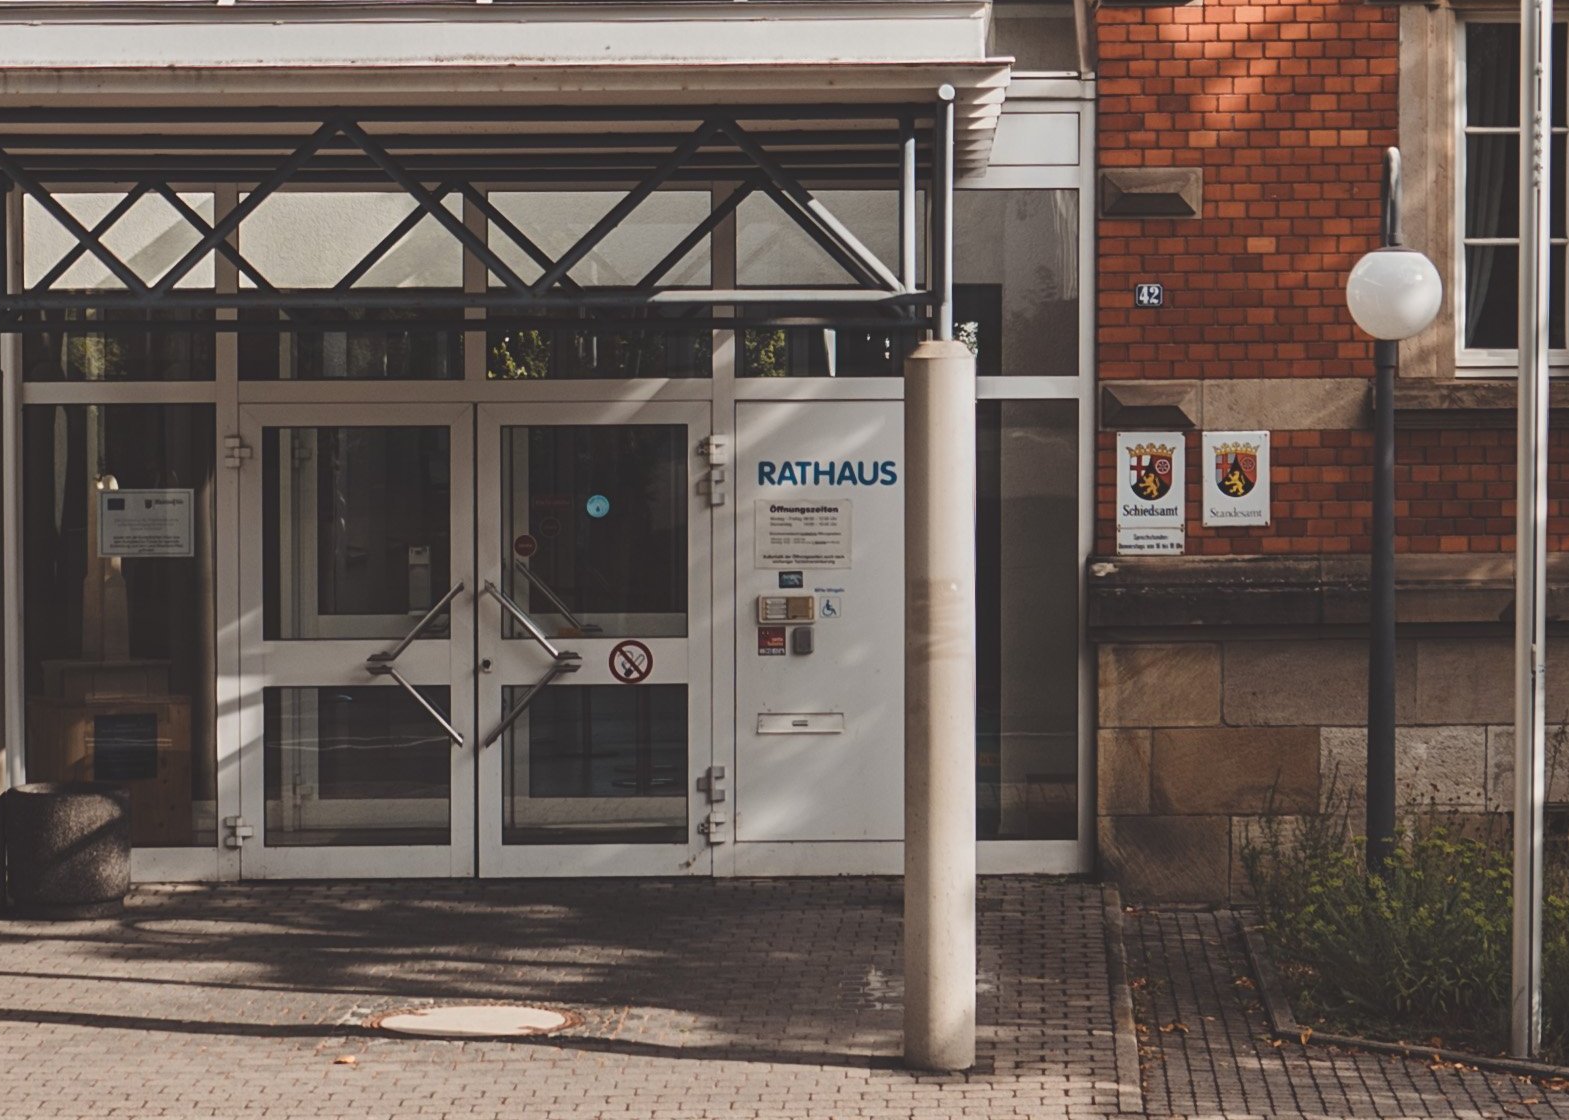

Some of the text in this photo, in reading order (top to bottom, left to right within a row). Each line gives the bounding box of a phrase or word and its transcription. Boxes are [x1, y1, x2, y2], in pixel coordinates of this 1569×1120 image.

[1139, 286, 1159, 304] 42
[758, 461, 897, 486] RATHAUS
[770, 504, 839, 515] Öffnungszeiten
[1122, 504, 1178, 517] Schiedsamt
[1210, 507, 1262, 518] Standesamt
